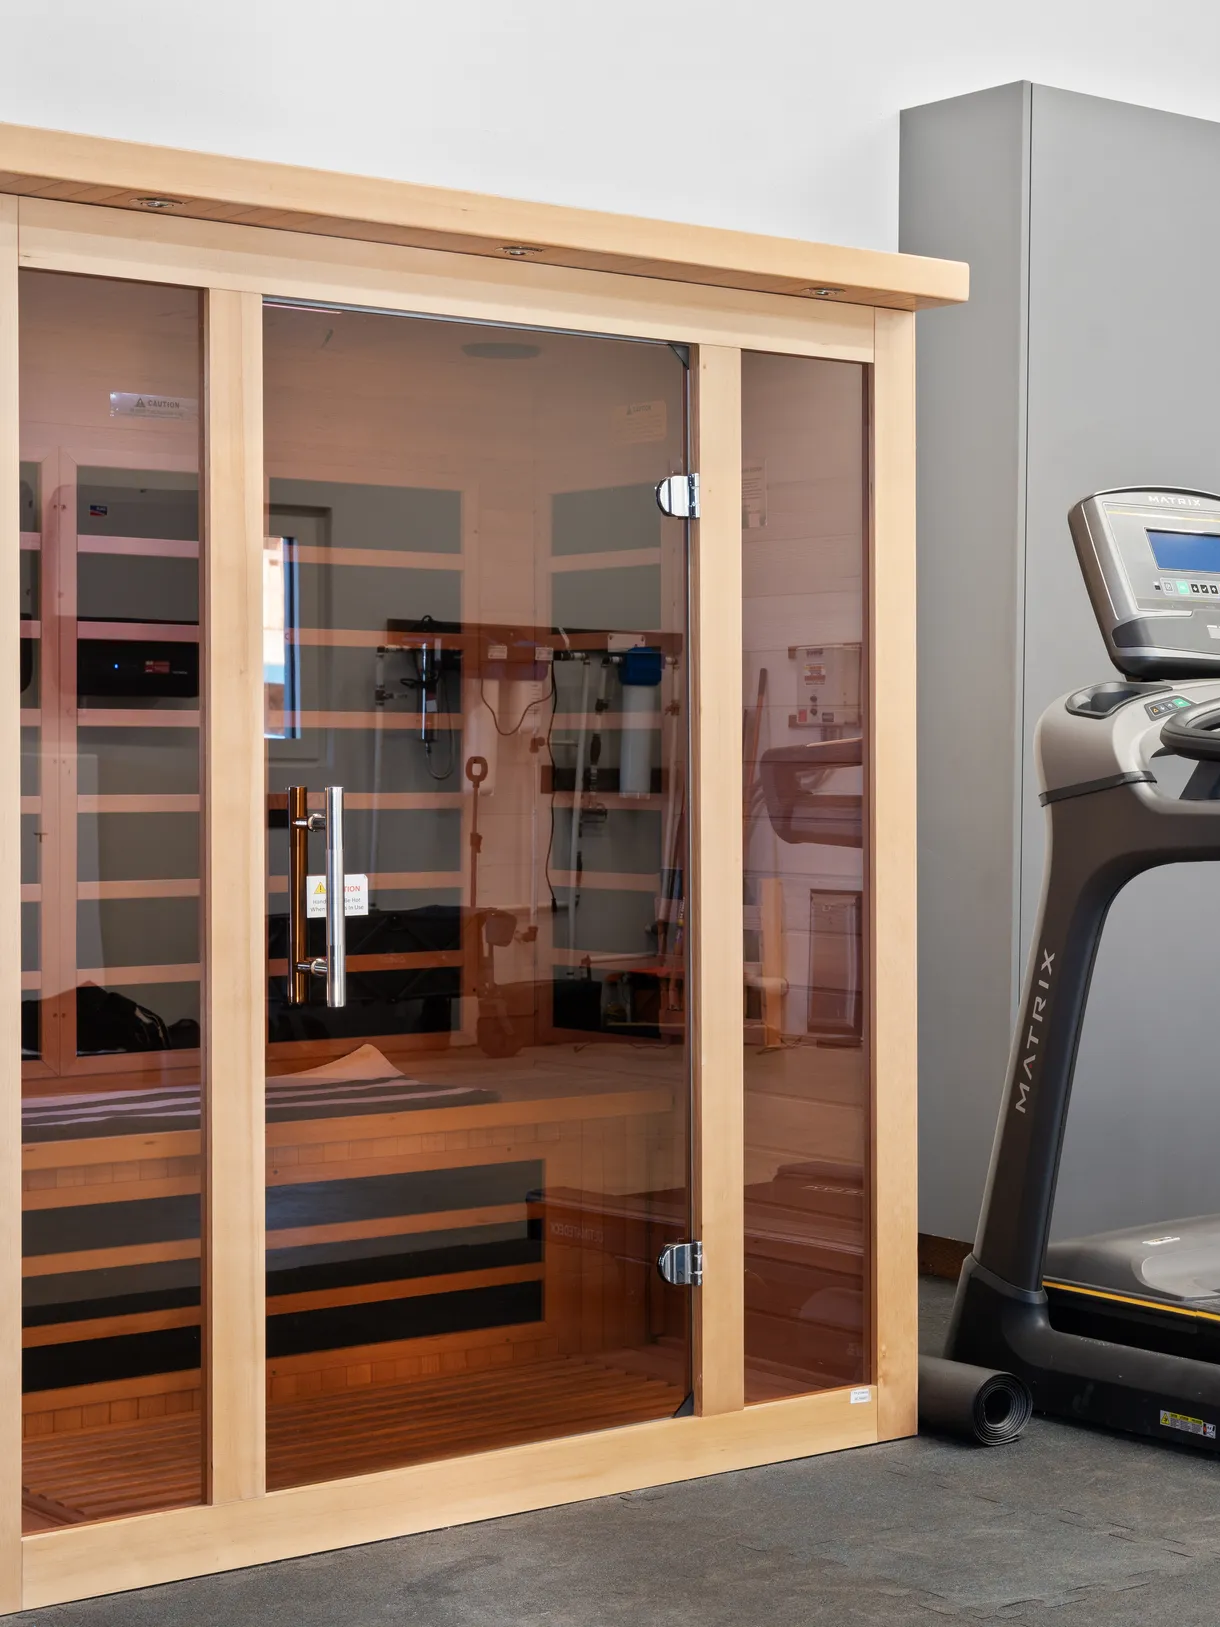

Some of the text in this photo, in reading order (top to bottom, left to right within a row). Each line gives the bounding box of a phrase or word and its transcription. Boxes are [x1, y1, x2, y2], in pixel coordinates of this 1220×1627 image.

[148, 400, 180, 408] CAUTION
[1148, 496, 1200, 506] MATRIX
[1015, 947, 1056, 1114] MATRIX
